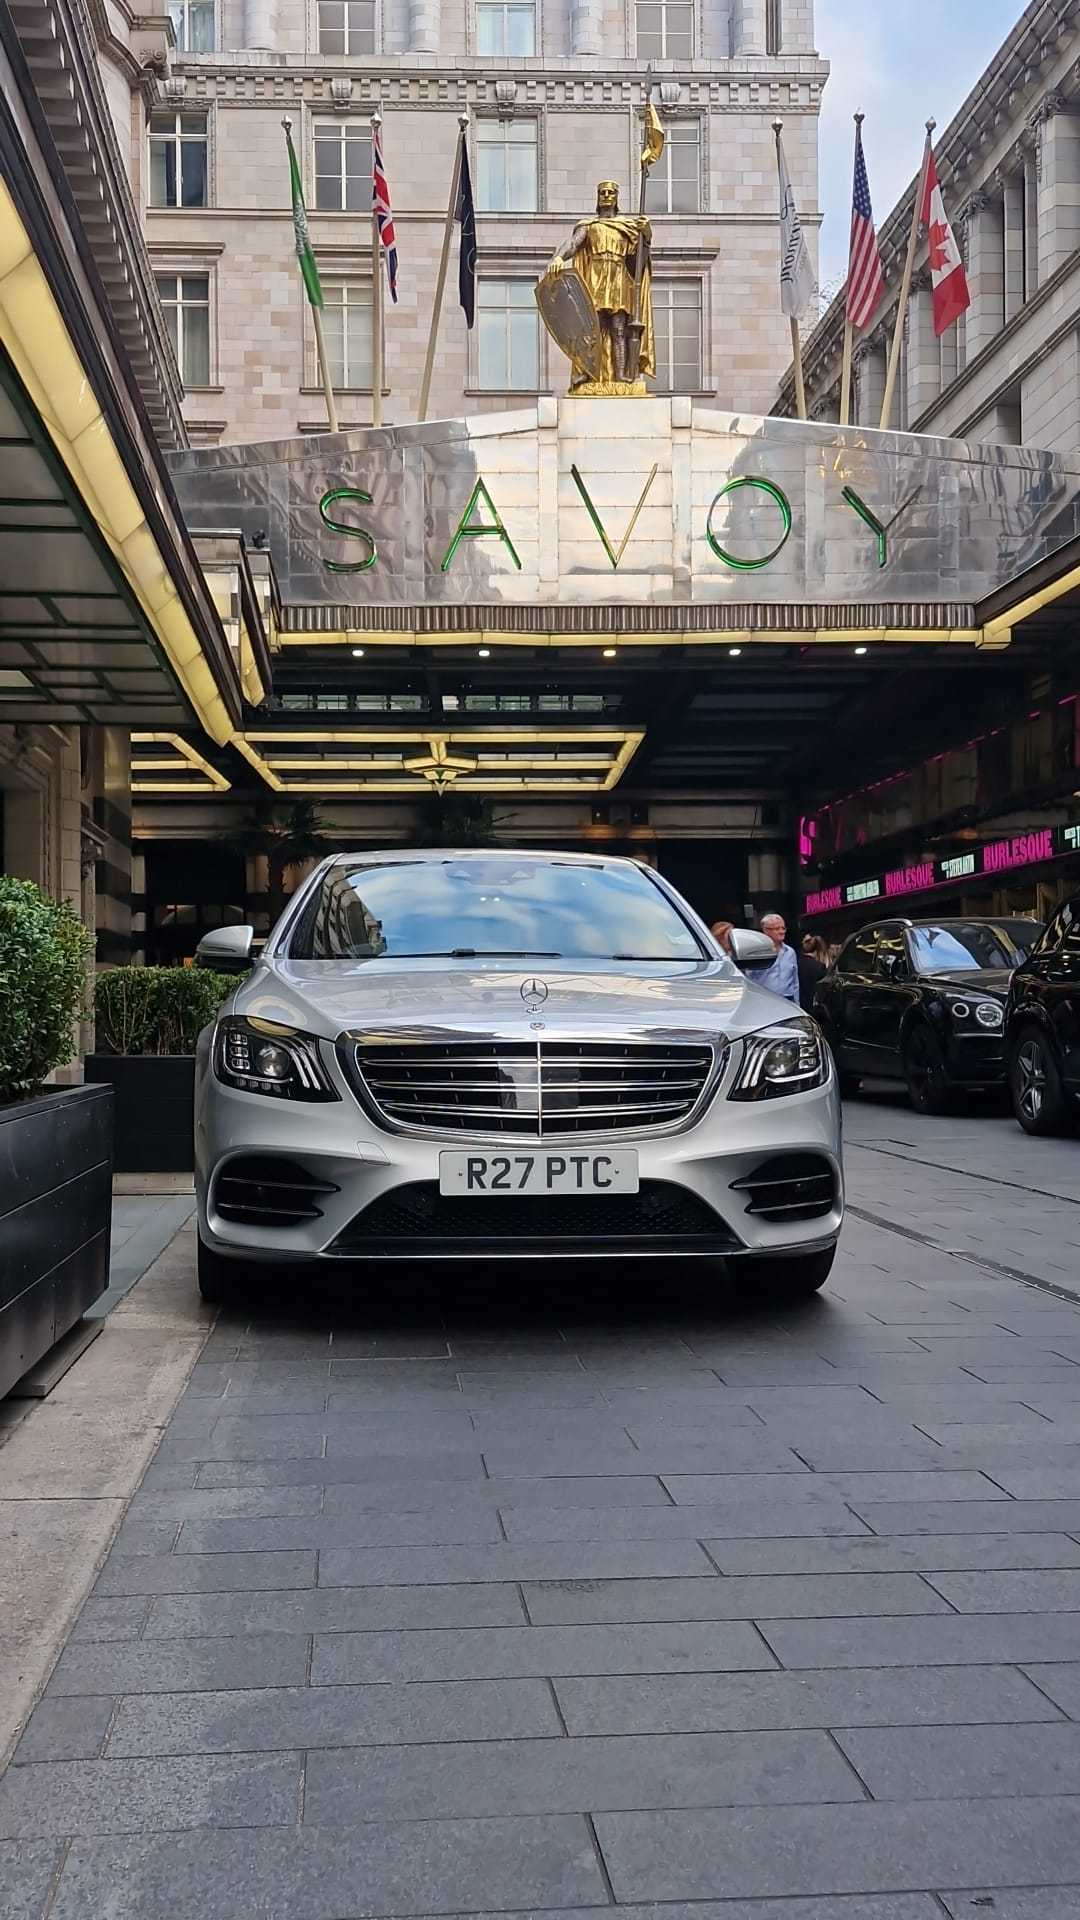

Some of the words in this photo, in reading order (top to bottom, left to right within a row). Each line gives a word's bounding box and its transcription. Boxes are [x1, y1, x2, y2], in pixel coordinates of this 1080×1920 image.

[319, 463, 925, 572] SAVOY
[983, 829, 1053, 871] BURLESQUE
[885, 862, 934, 893] BURLESQUE
[806, 886, 842, 913] BURLESQUE
[467, 1157, 535, 1189] R27
[546, 1156, 612, 1188] PTC
